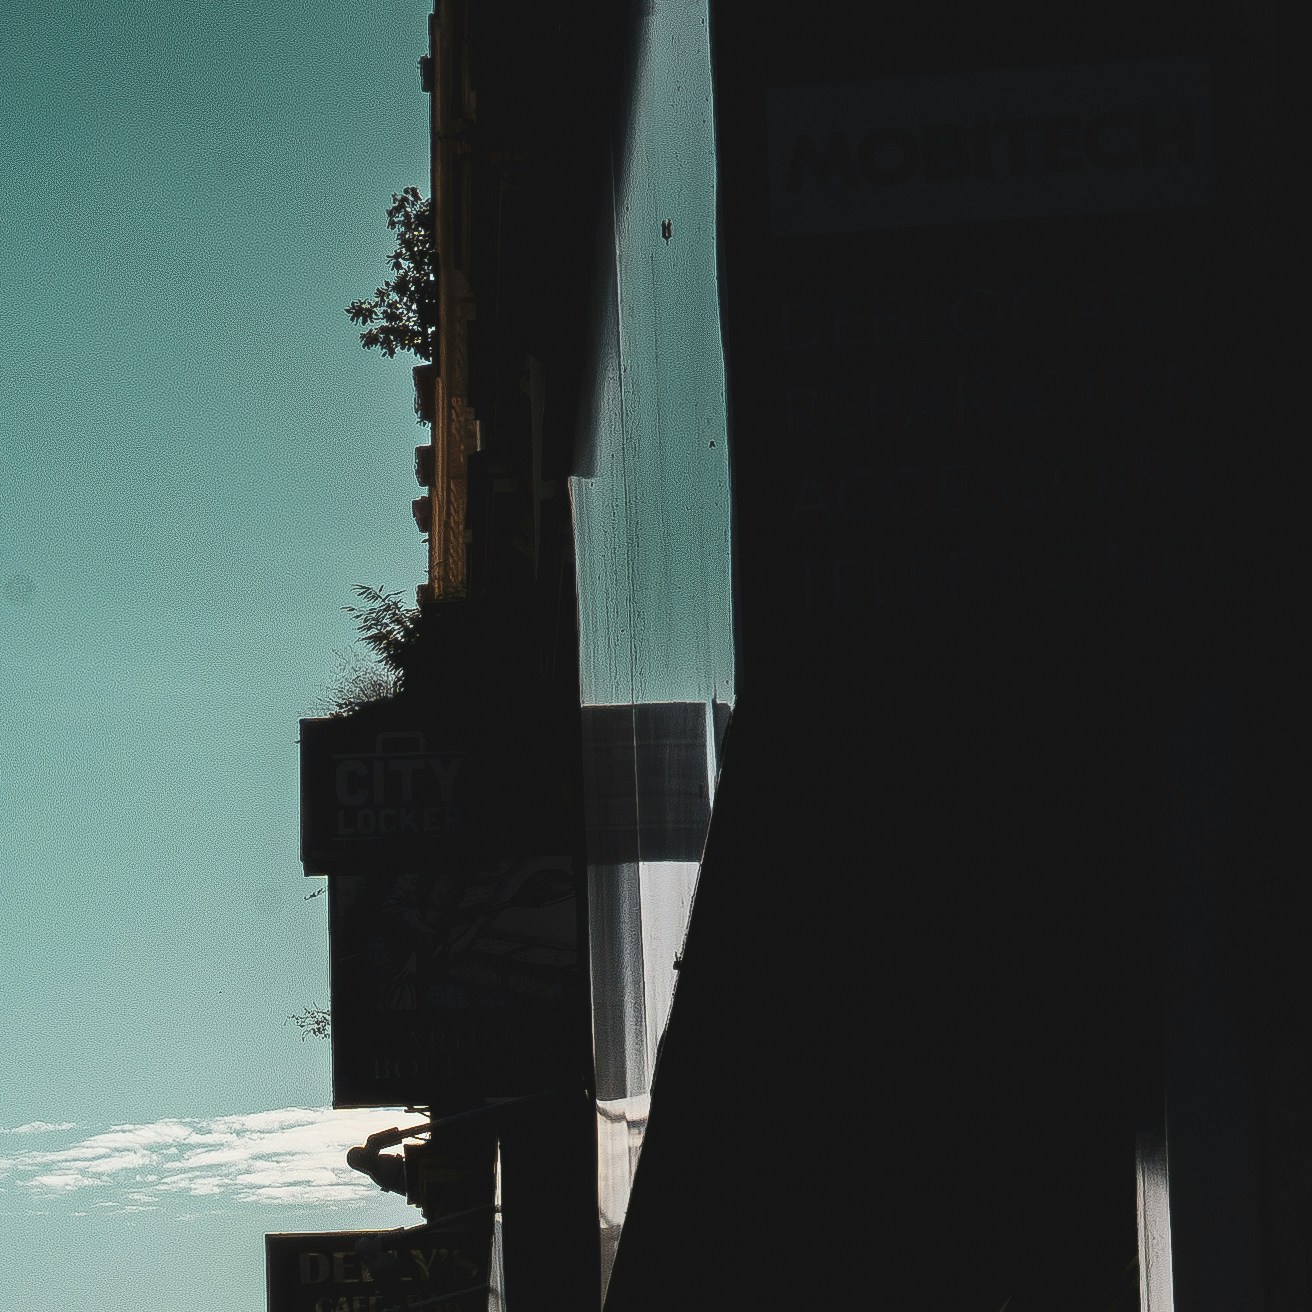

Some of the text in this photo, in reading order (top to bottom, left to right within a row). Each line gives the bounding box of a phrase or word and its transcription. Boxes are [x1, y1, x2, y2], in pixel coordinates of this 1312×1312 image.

[785, 107, 1196, 193] MOBITECH
[335, 757, 463, 806] CITY
[337, 807, 464, 835] LOCKER
